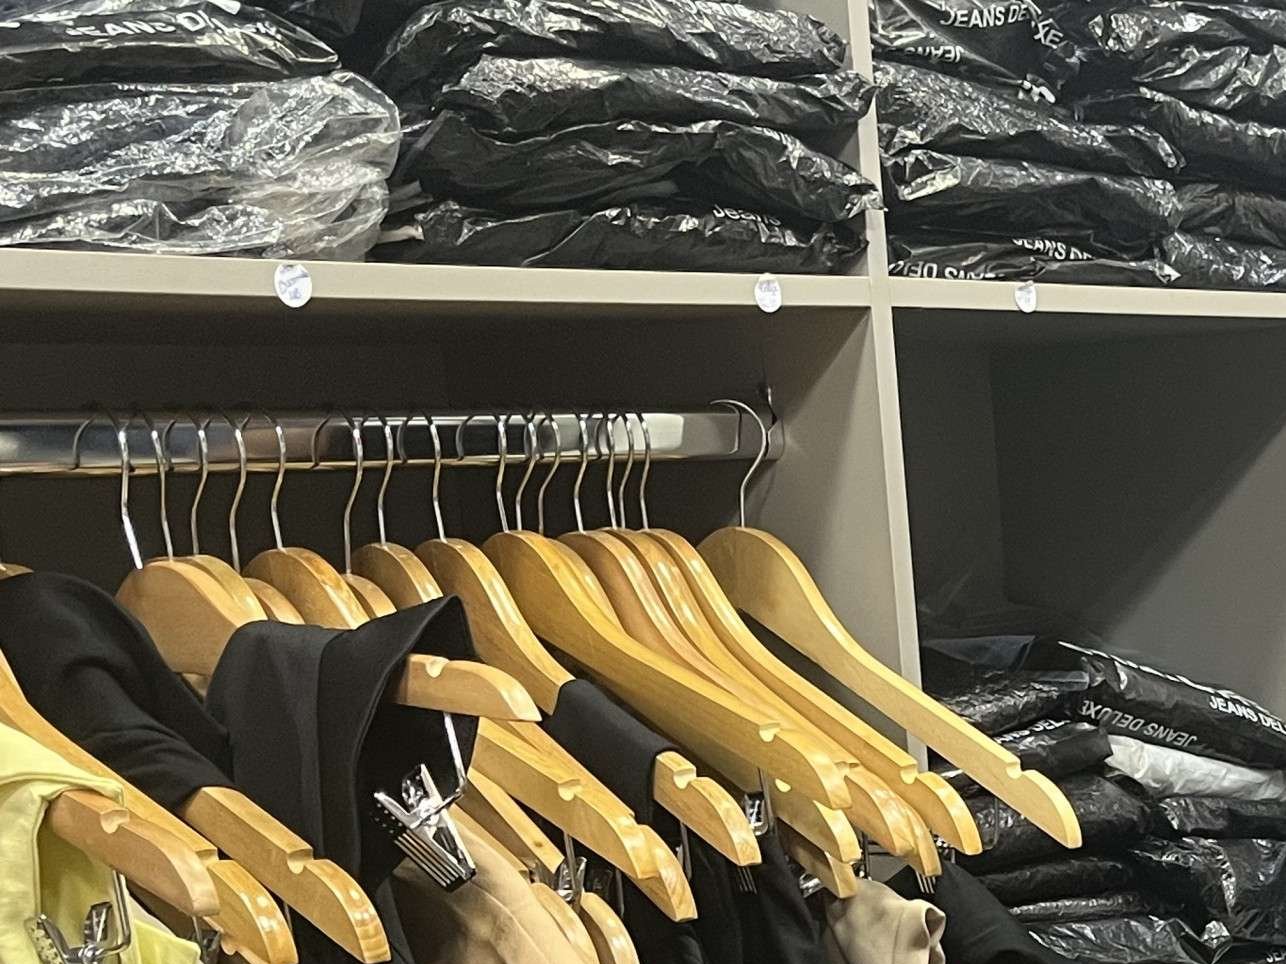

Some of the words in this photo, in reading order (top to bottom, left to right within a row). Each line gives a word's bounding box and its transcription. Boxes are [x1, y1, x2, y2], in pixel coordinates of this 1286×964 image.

[940, 5, 1005, 28] JEANS
[1080, 699, 1145, 731] DELUXE
[1208, 695, 1260, 723] JEANS
[1143, 722, 1199, 748] JEANS
